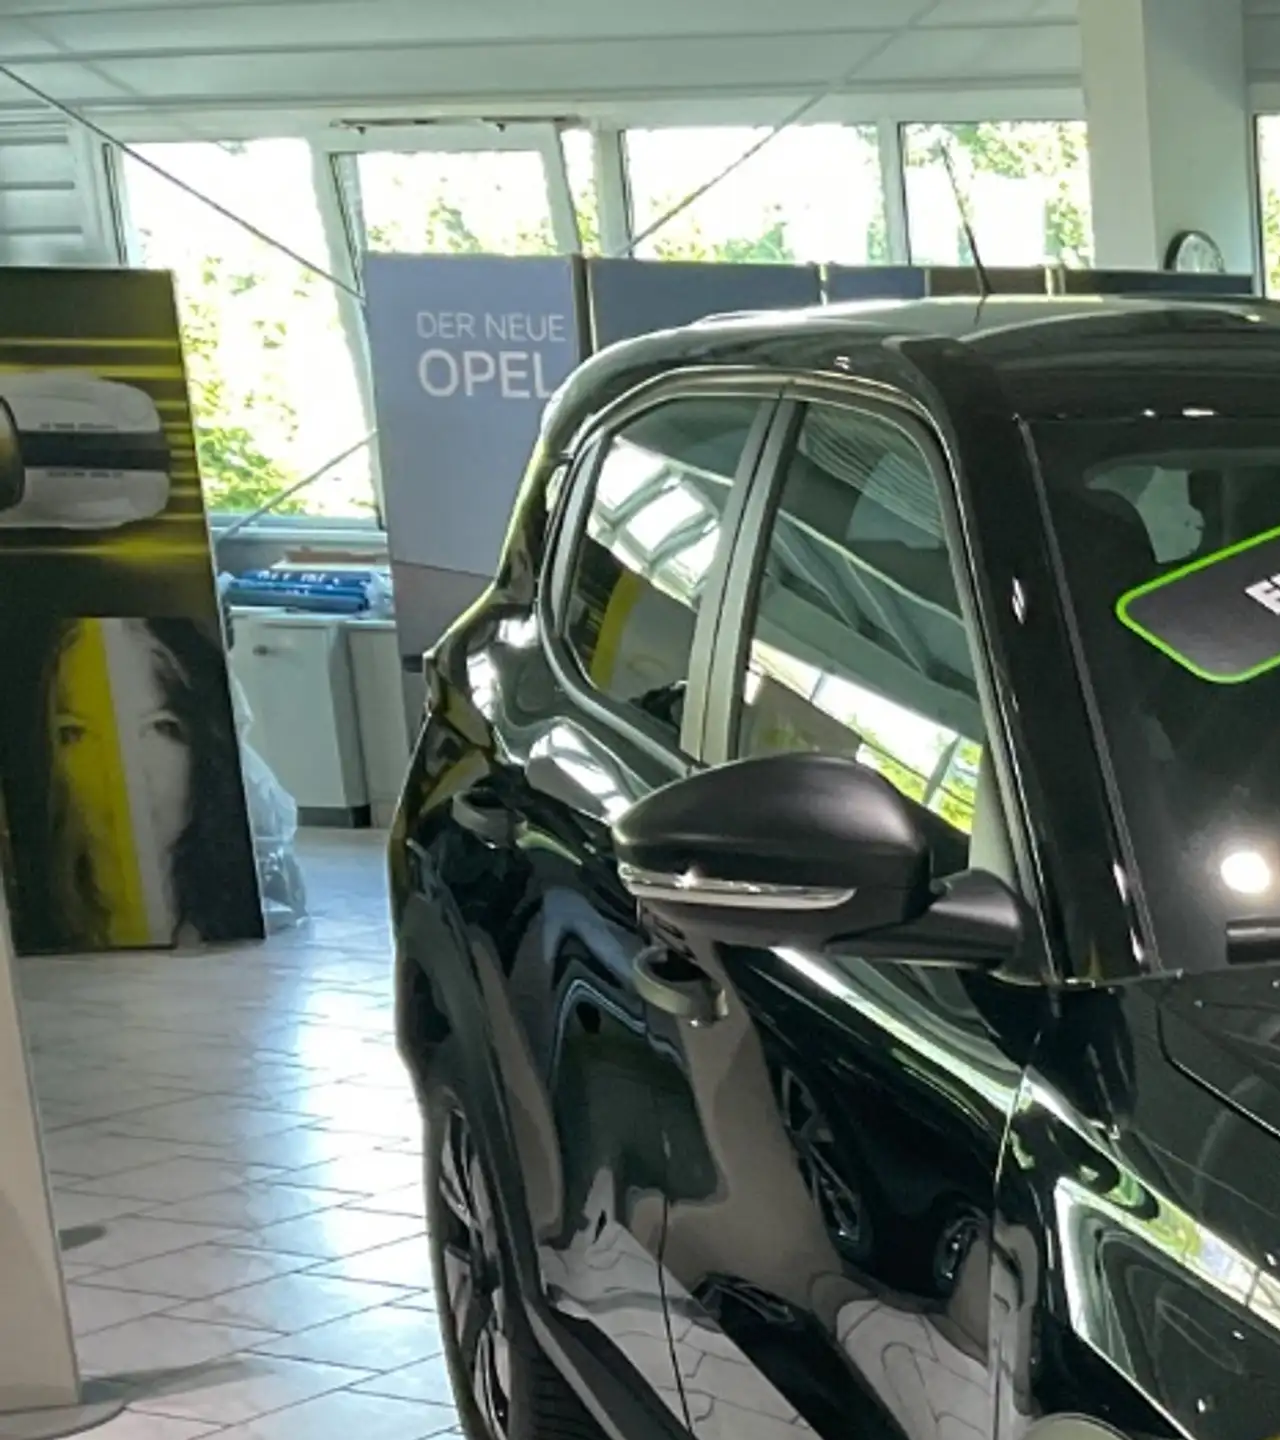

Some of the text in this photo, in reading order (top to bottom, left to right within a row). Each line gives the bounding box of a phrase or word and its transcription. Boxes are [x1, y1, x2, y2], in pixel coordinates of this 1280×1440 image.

[416, 311, 567, 342] DER NEUE
[417, 347, 553, 399] OPEL
